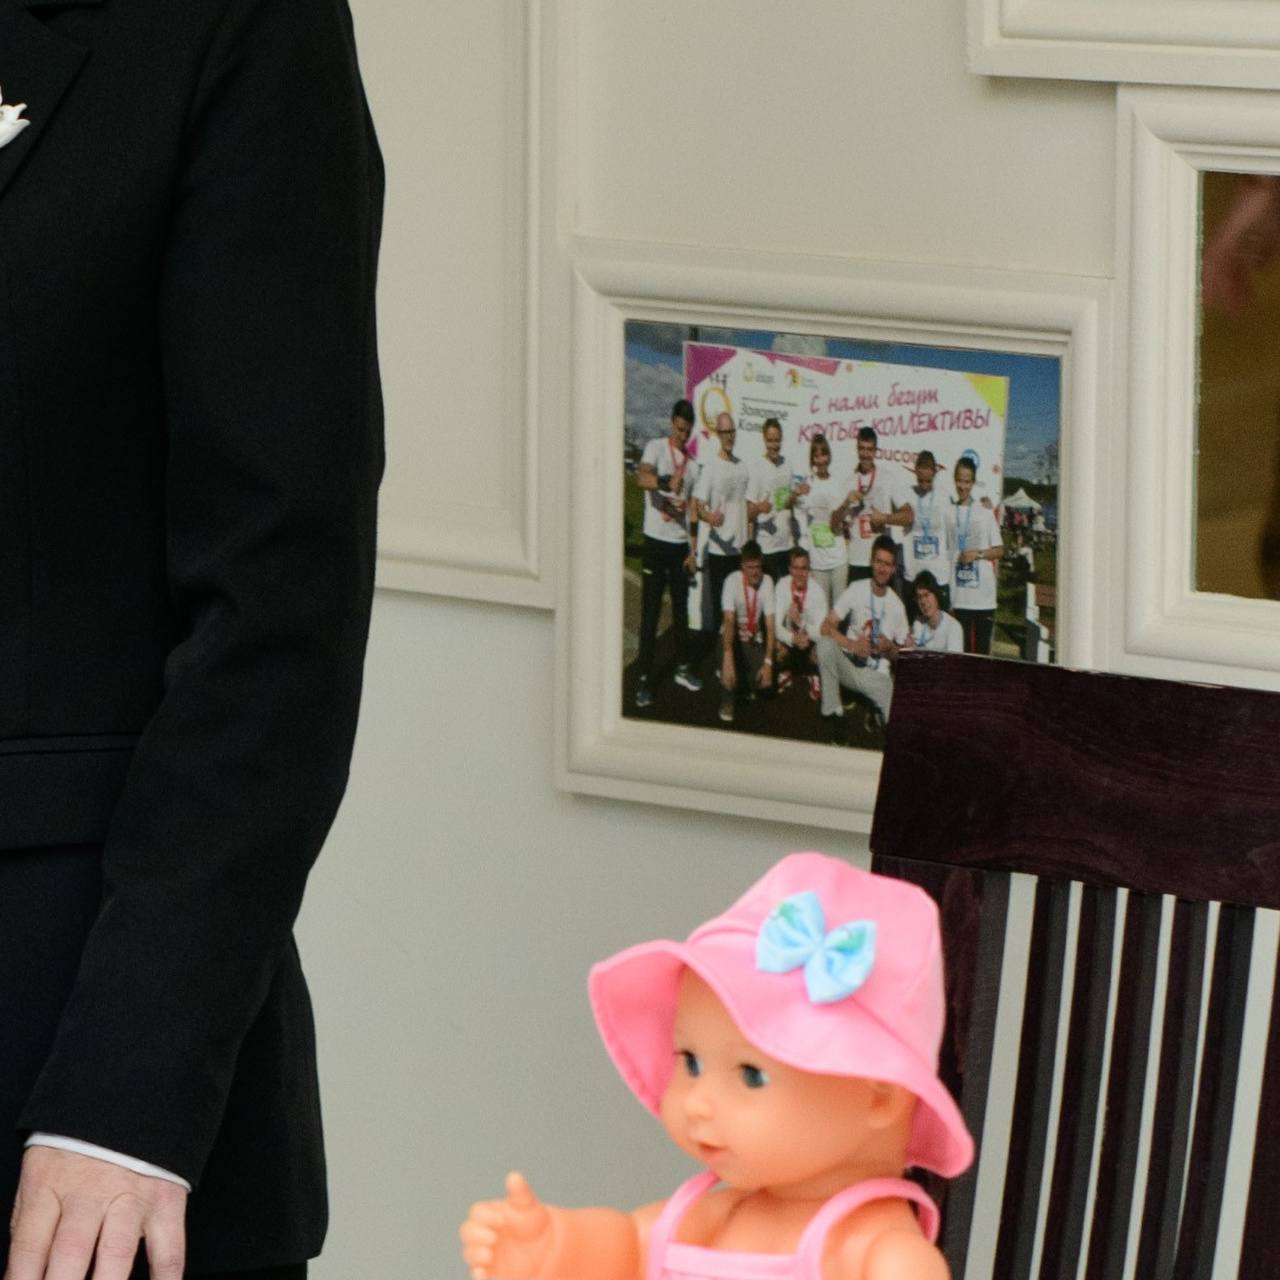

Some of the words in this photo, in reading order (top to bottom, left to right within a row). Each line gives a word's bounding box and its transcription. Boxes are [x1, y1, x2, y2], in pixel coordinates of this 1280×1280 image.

[827, 393, 879, 413] нами
[887, 382, 939, 412] бегут
[871, 407, 993, 437] КОЛЛЕКТИВЫ
